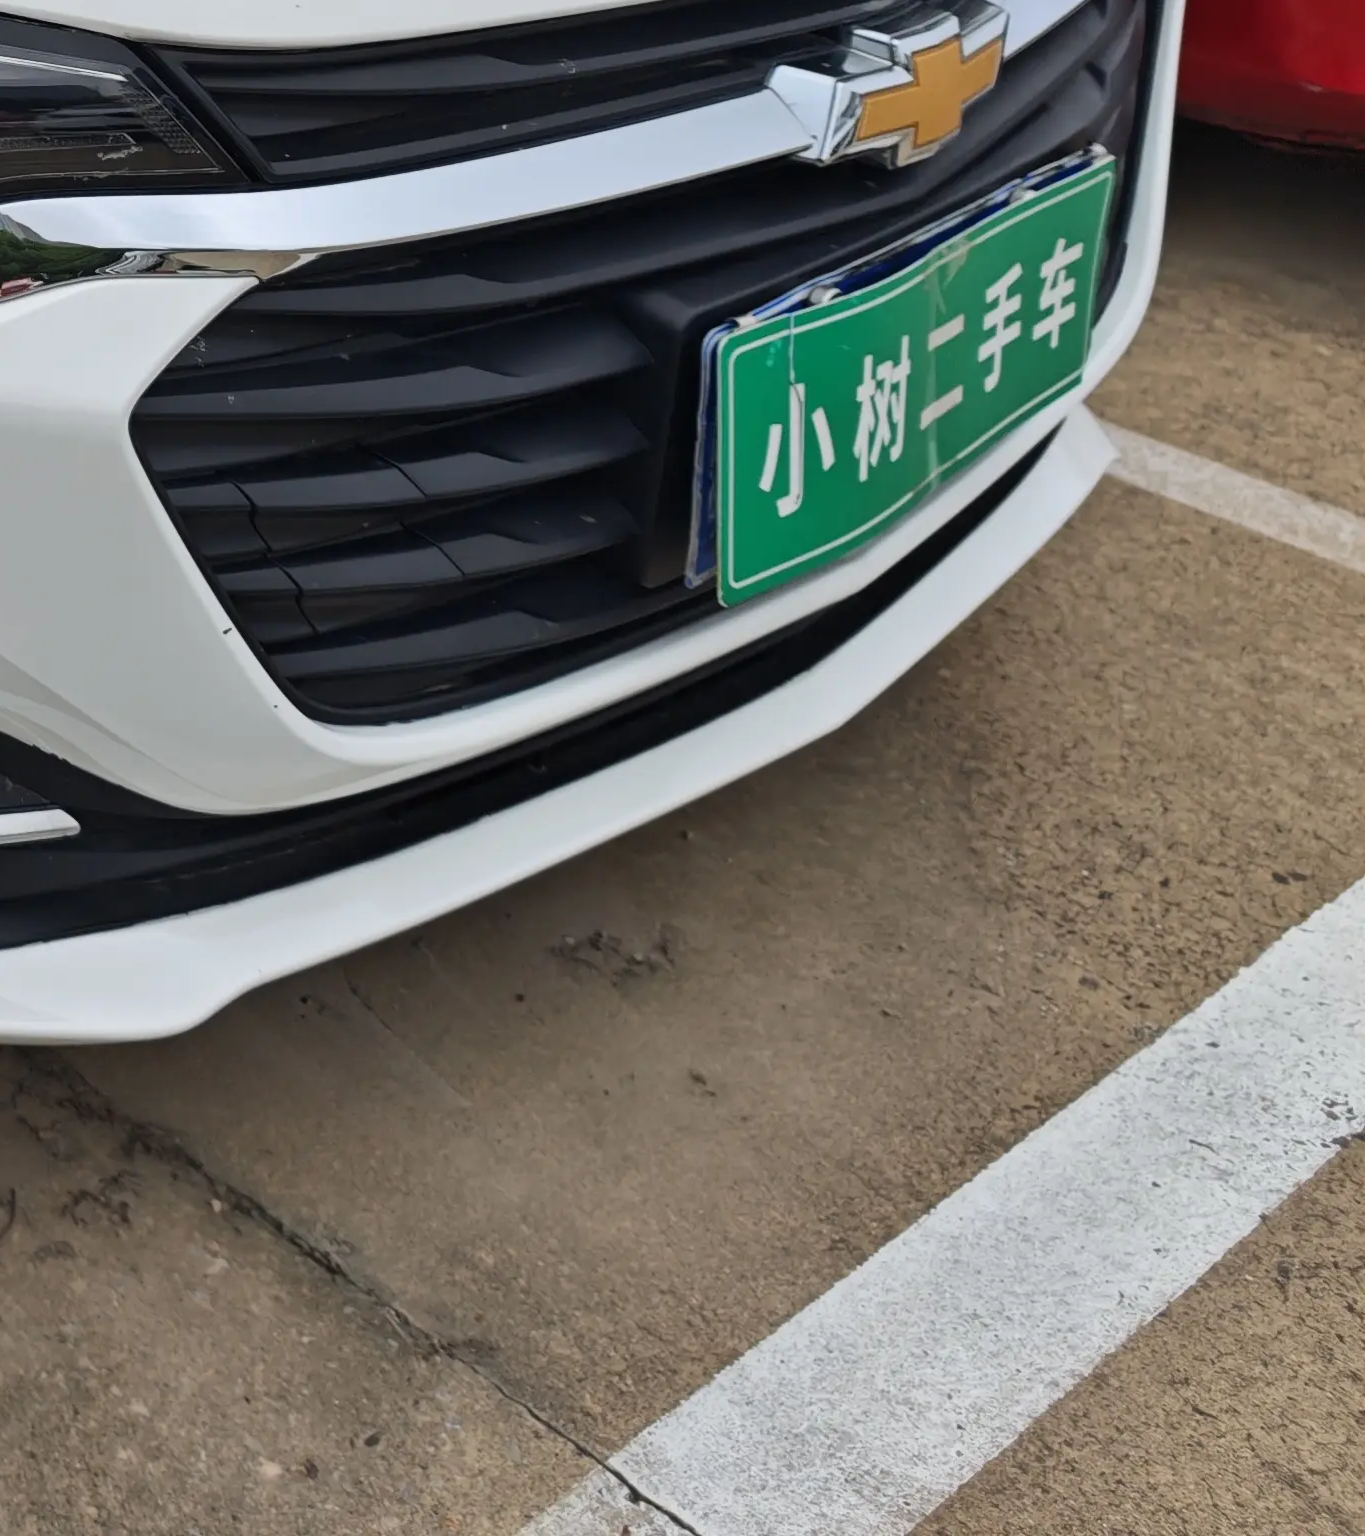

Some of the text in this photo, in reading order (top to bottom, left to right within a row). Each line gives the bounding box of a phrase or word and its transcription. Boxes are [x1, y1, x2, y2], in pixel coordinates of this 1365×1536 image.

[758, 237, 1084, 518] 小树二手车
